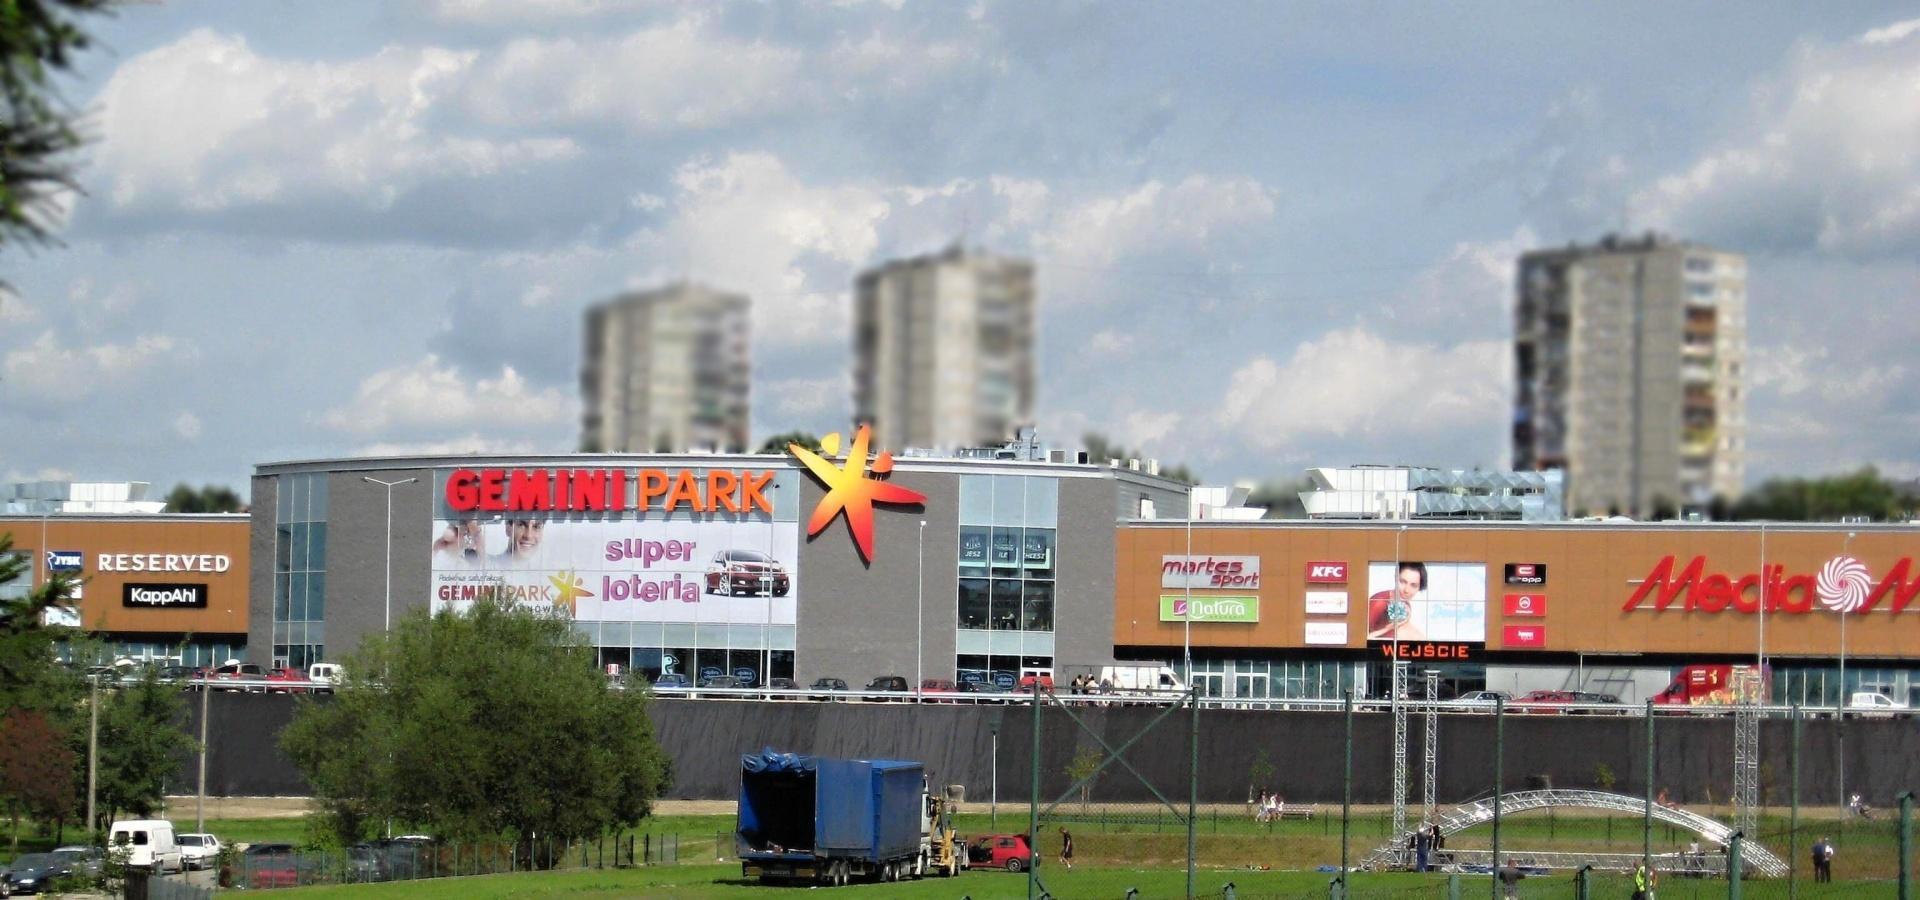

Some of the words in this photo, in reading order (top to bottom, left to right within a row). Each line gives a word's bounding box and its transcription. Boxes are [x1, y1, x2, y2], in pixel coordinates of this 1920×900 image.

[445, 469, 626, 512] GEMINI
[638, 470, 776, 513] PARK
[54, 555, 81, 566] JYSK
[605, 538, 697, 568] super
[99, 553, 231, 573] RESERVED
[1163, 557, 1244, 576] martes
[1311, 565, 1344, 577] KFC
[602, 573, 700, 603] loteria
[1209, 571, 1259, 588] sport
[1621, 555, 1816, 613] Media
[131, 587, 196, 605] KappAhl
[1382, 643, 1469, 657] WEJŚCIE
